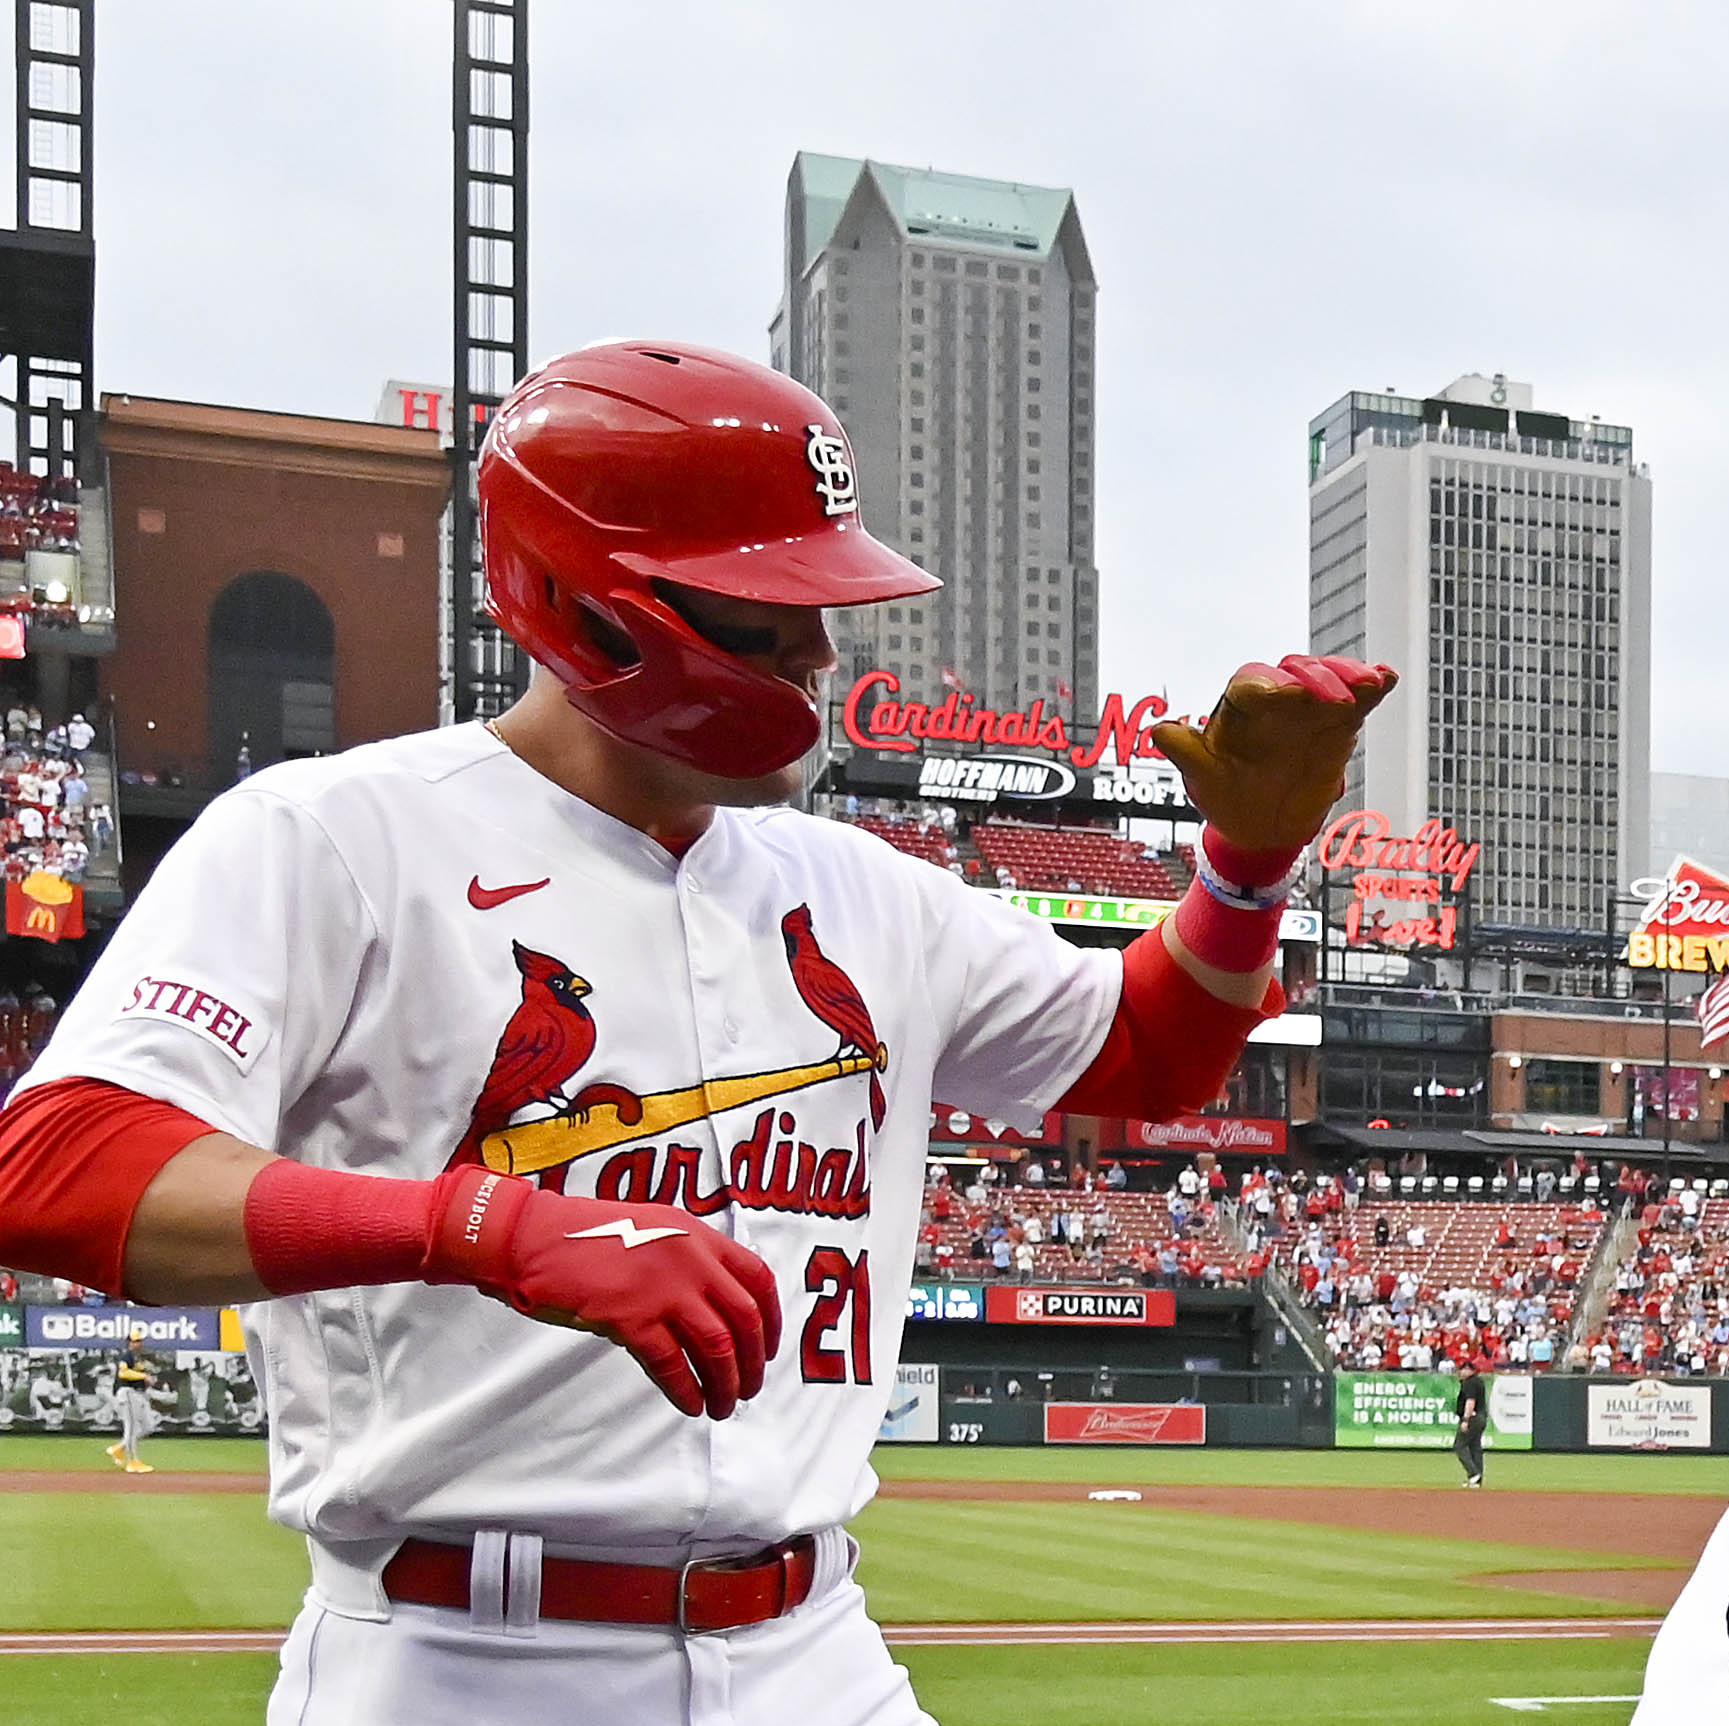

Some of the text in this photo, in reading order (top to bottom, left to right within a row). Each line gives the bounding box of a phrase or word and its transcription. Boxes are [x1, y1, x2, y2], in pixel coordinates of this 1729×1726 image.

[843, 670, 1070, 752] Cardinals
[919, 757, 1049, 794] HOFFMANN
[1093, 776, 1194, 807] ROOFT
[1318, 809, 1481, 892] Bally
[1354, 873, 1440, 903] SPORTS
[122, 976, 252, 1058] STIFEL
[465, 1204, 485, 1243] BOLT
[800, 1245, 873, 1385] 21
[1046, 1297, 1140, 1316] PURINA
[75, 1314, 198, 1341] Ballpark
[1353, 1382, 1416, 1396] ENERGY
[1353, 1397, 1446, 1410] EFFICIENCY
[1353, 1410, 1459, 1425] IS A HOME RU
[1606, 1399, 1640, 1413] HALL
[1656, 1400, 1694, 1414] FAME
[950, 1422, 983, 1443] 375'
[1653, 1425, 1690, 1439] Jones
